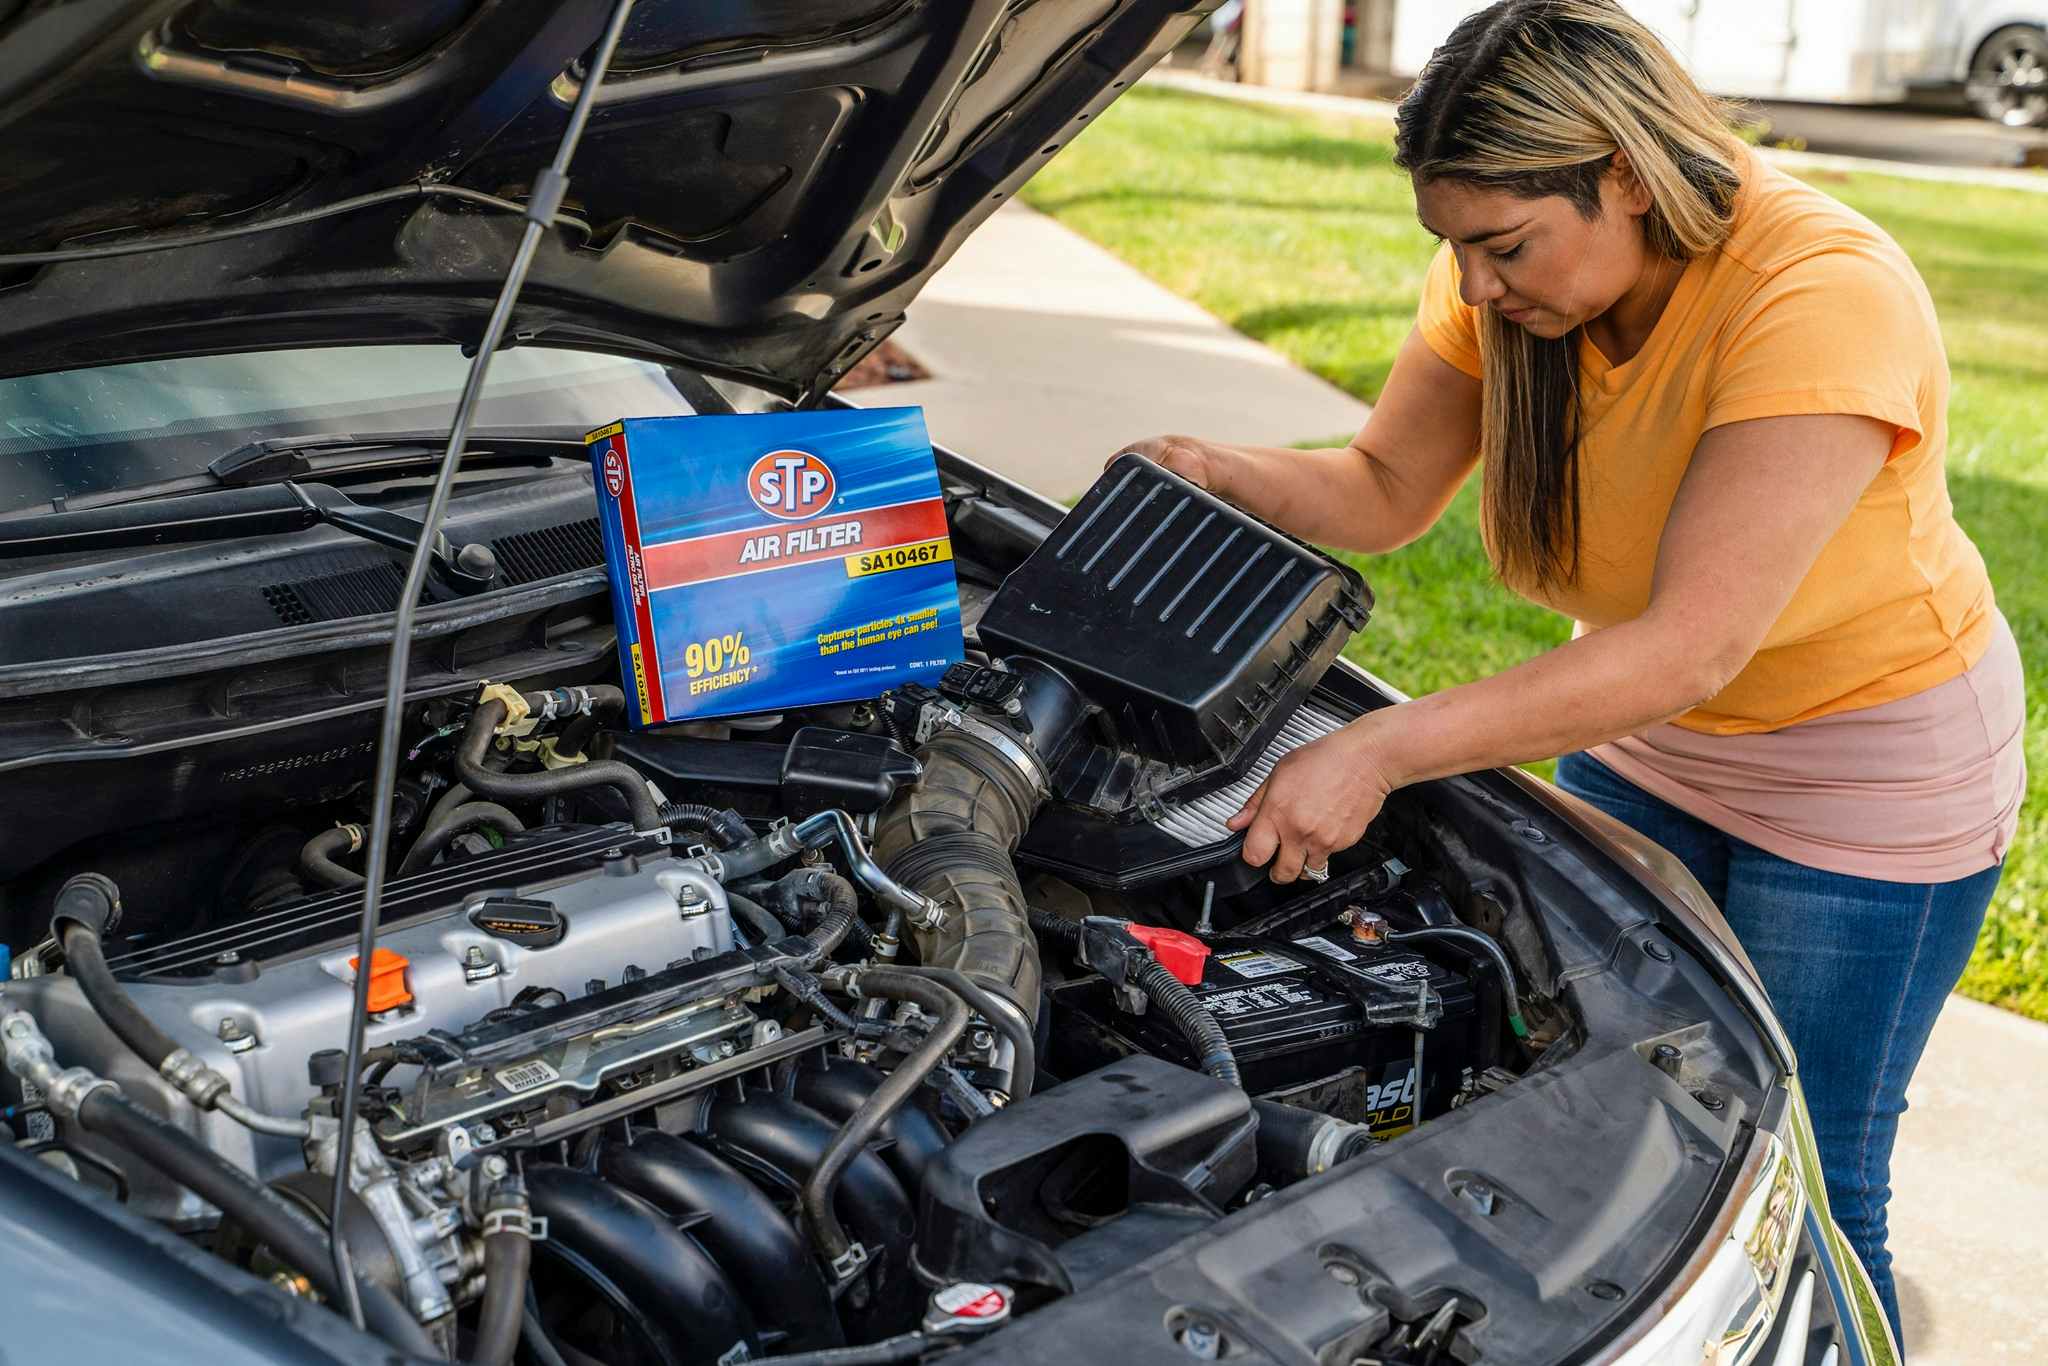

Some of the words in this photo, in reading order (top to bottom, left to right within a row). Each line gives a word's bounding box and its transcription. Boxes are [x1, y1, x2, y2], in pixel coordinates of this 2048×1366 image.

[606, 455, 623, 491] STP
[759, 457, 826, 511] STP
[739, 535, 781, 564] AIR
[786, 521, 862, 556] FILTER
[860, 545, 939, 572] SA10467
[817, 630, 855, 644] Captures
[857, 619, 894, 635] particles
[908, 608, 939, 623] smaller
[820, 644, 840, 656] than
[841, 640, 855, 652] the
[857, 632, 886, 647] human
[887, 628, 902, 641] eye
[904, 623, 919, 636] can
[921, 618, 938, 632] see!
[685, 631, 750, 678] 90%
[909, 660, 925, 669] CONT.
[930, 659, 947, 667] FILTER
[633, 653, 649, 714] SA10467
